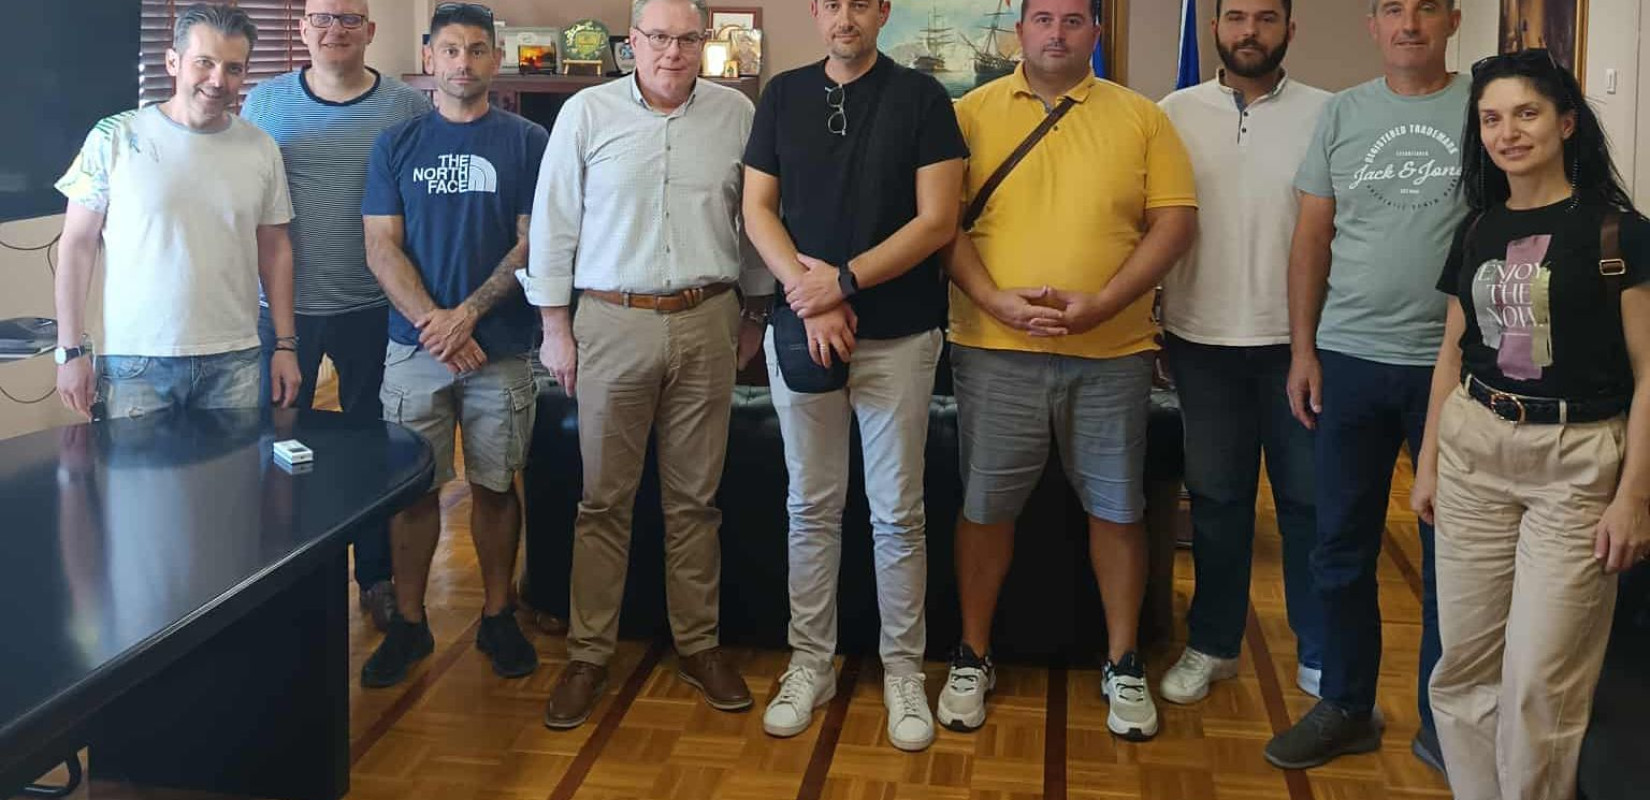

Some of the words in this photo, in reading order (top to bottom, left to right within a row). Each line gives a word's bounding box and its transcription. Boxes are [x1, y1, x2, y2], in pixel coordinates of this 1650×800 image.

[1364, 124, 1407, 163] REGISTERED
[1410, 124, 1459, 154] TRADEMARK
[438, 153, 470, 169] THE
[413, 167, 468, 182] NORTH
[1348, 163, 1396, 190] Jack
[1398, 160, 1417, 179] &
[1412, 158, 1462, 185] Jone
[428, 180, 469, 194] FACE
[1478, 262, 1548, 283] ENJOY
[1486, 283, 1534, 305] THE
